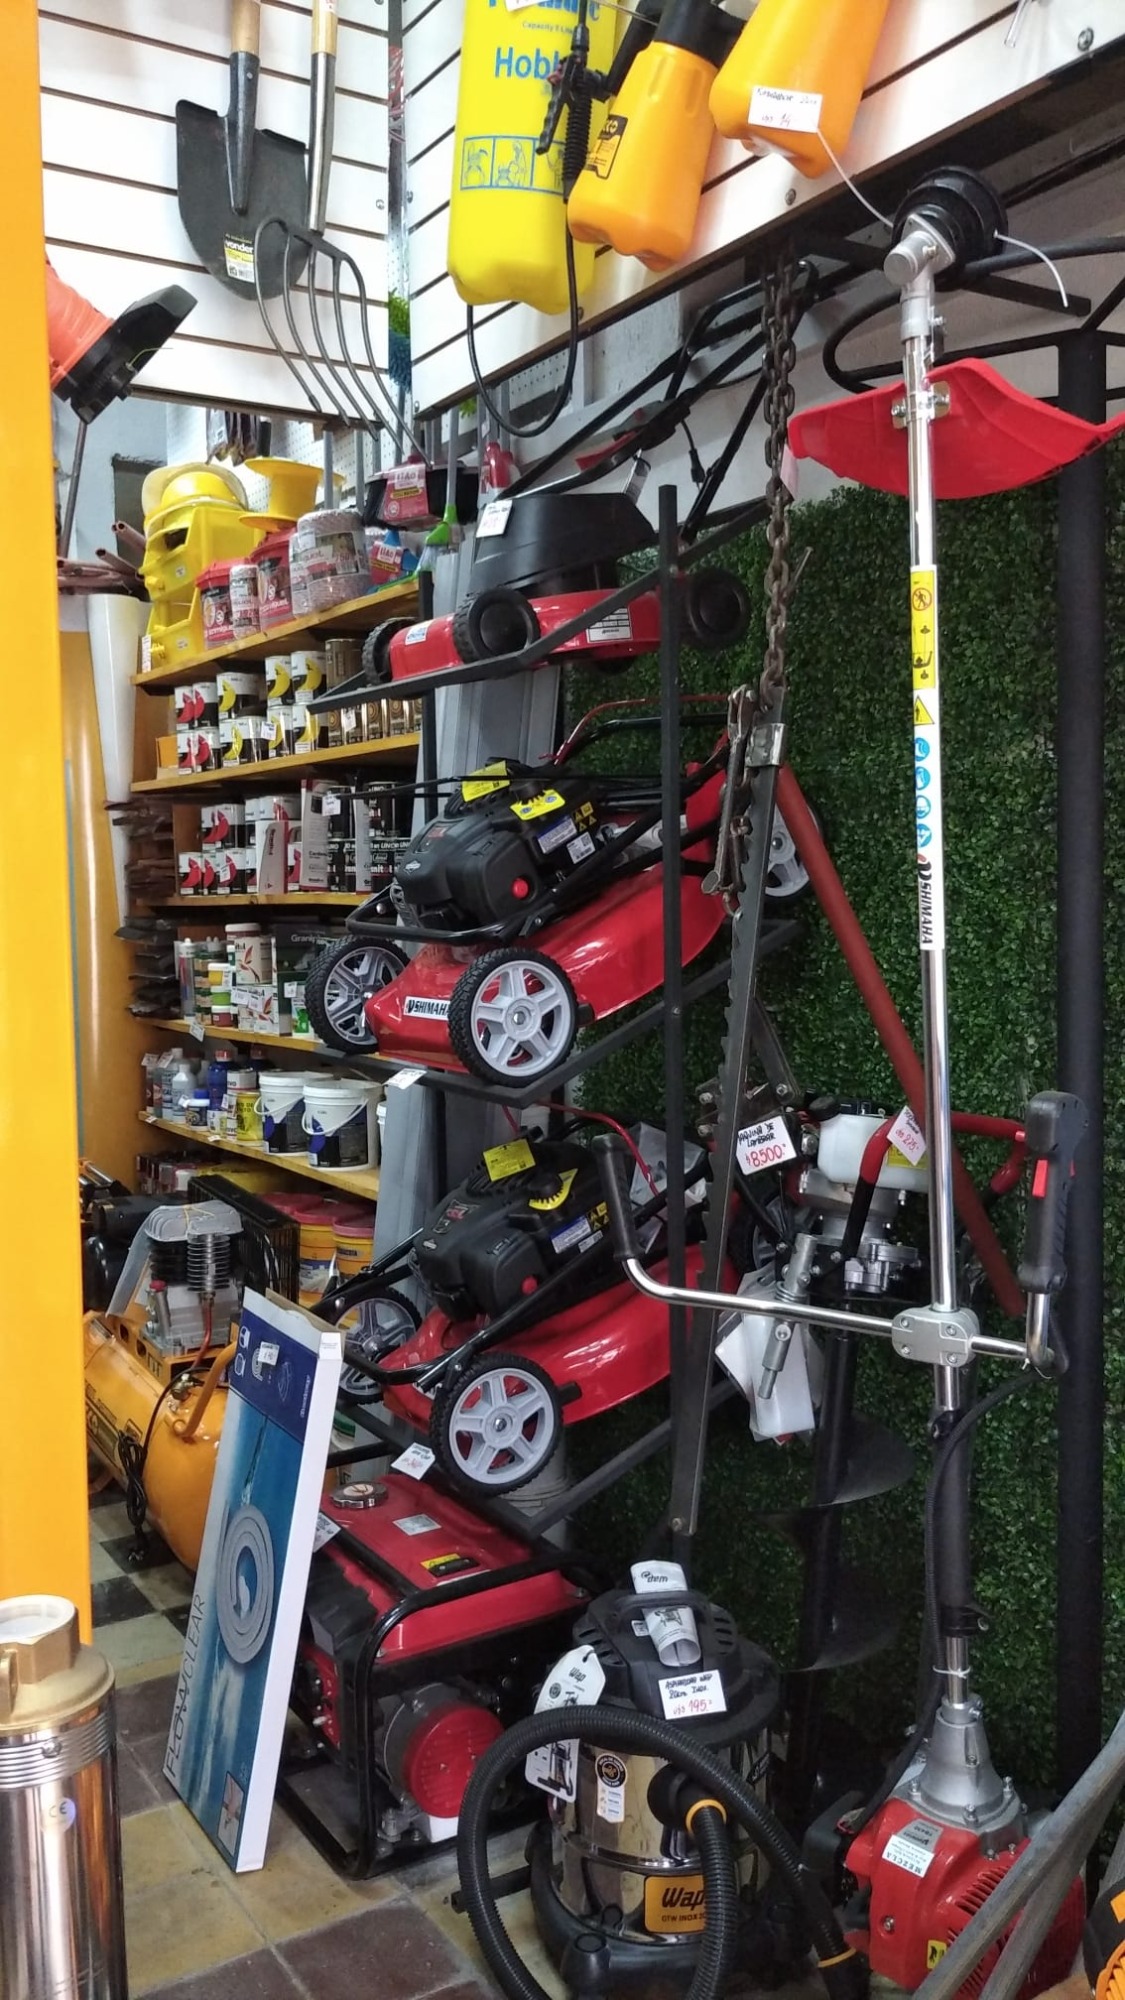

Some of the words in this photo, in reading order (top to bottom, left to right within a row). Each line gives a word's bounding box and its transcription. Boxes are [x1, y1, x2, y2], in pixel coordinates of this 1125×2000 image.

[886, 1851, 923, 1874] MEZCLA
[661, 1886, 705, 1911] Wap
[678, 1913, 698, 1922] INOX
